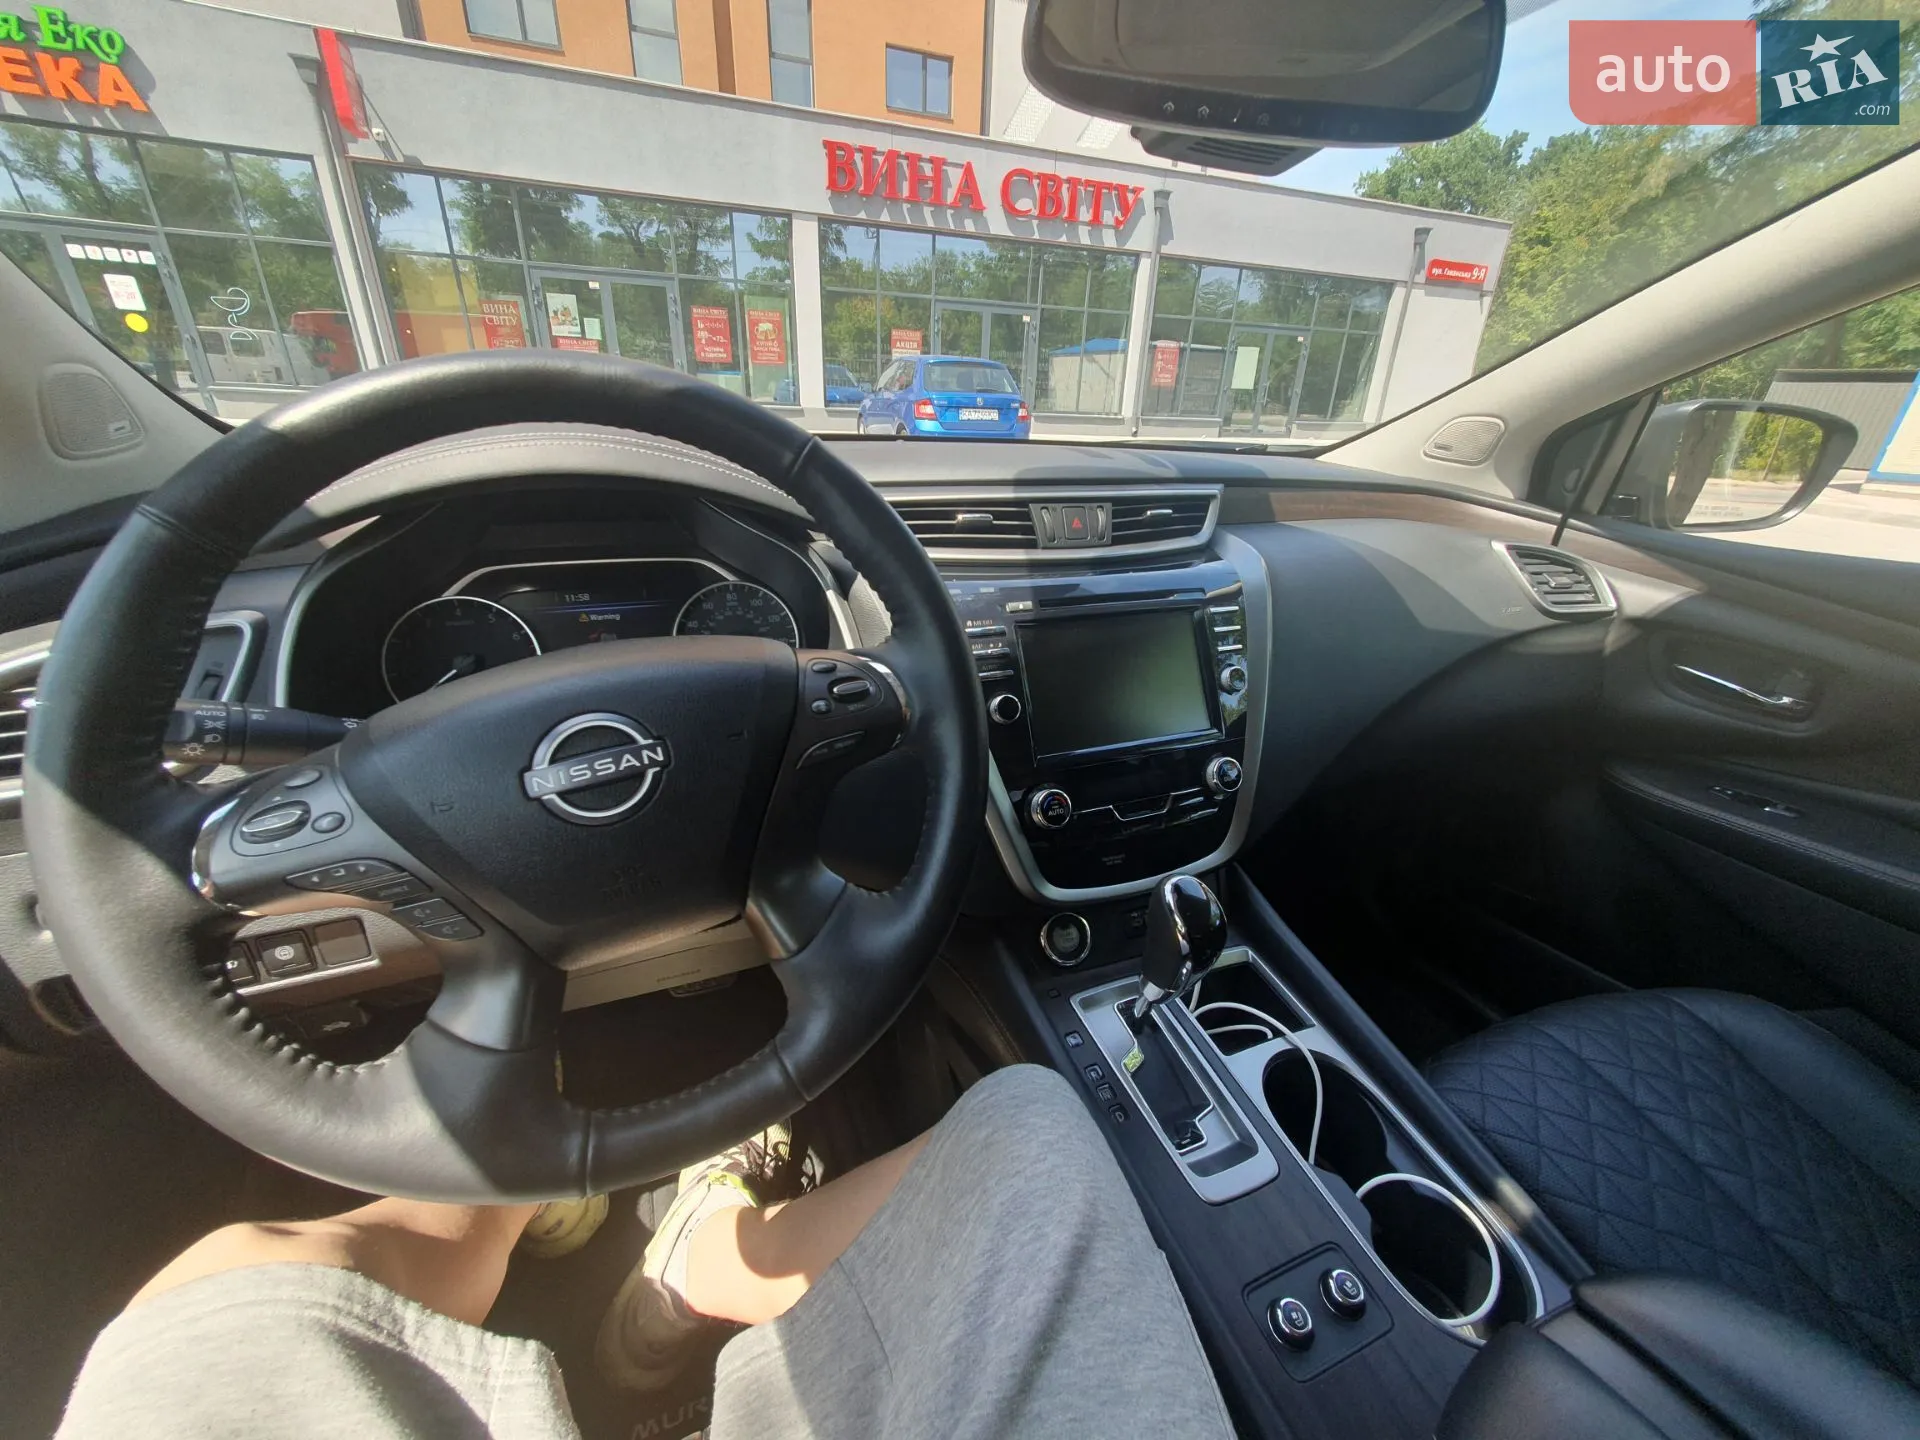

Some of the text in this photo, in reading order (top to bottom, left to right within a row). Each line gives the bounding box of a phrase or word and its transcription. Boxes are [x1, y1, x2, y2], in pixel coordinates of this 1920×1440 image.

[0, 46, 150, 113] ЕКА
[822, 139, 1145, 229] ВИНА СВІТУ
[482, 303, 517, 314] ВИНА
[485, 315, 518, 326] СВІТУ
[531, 746, 665, 793] NISSAN
